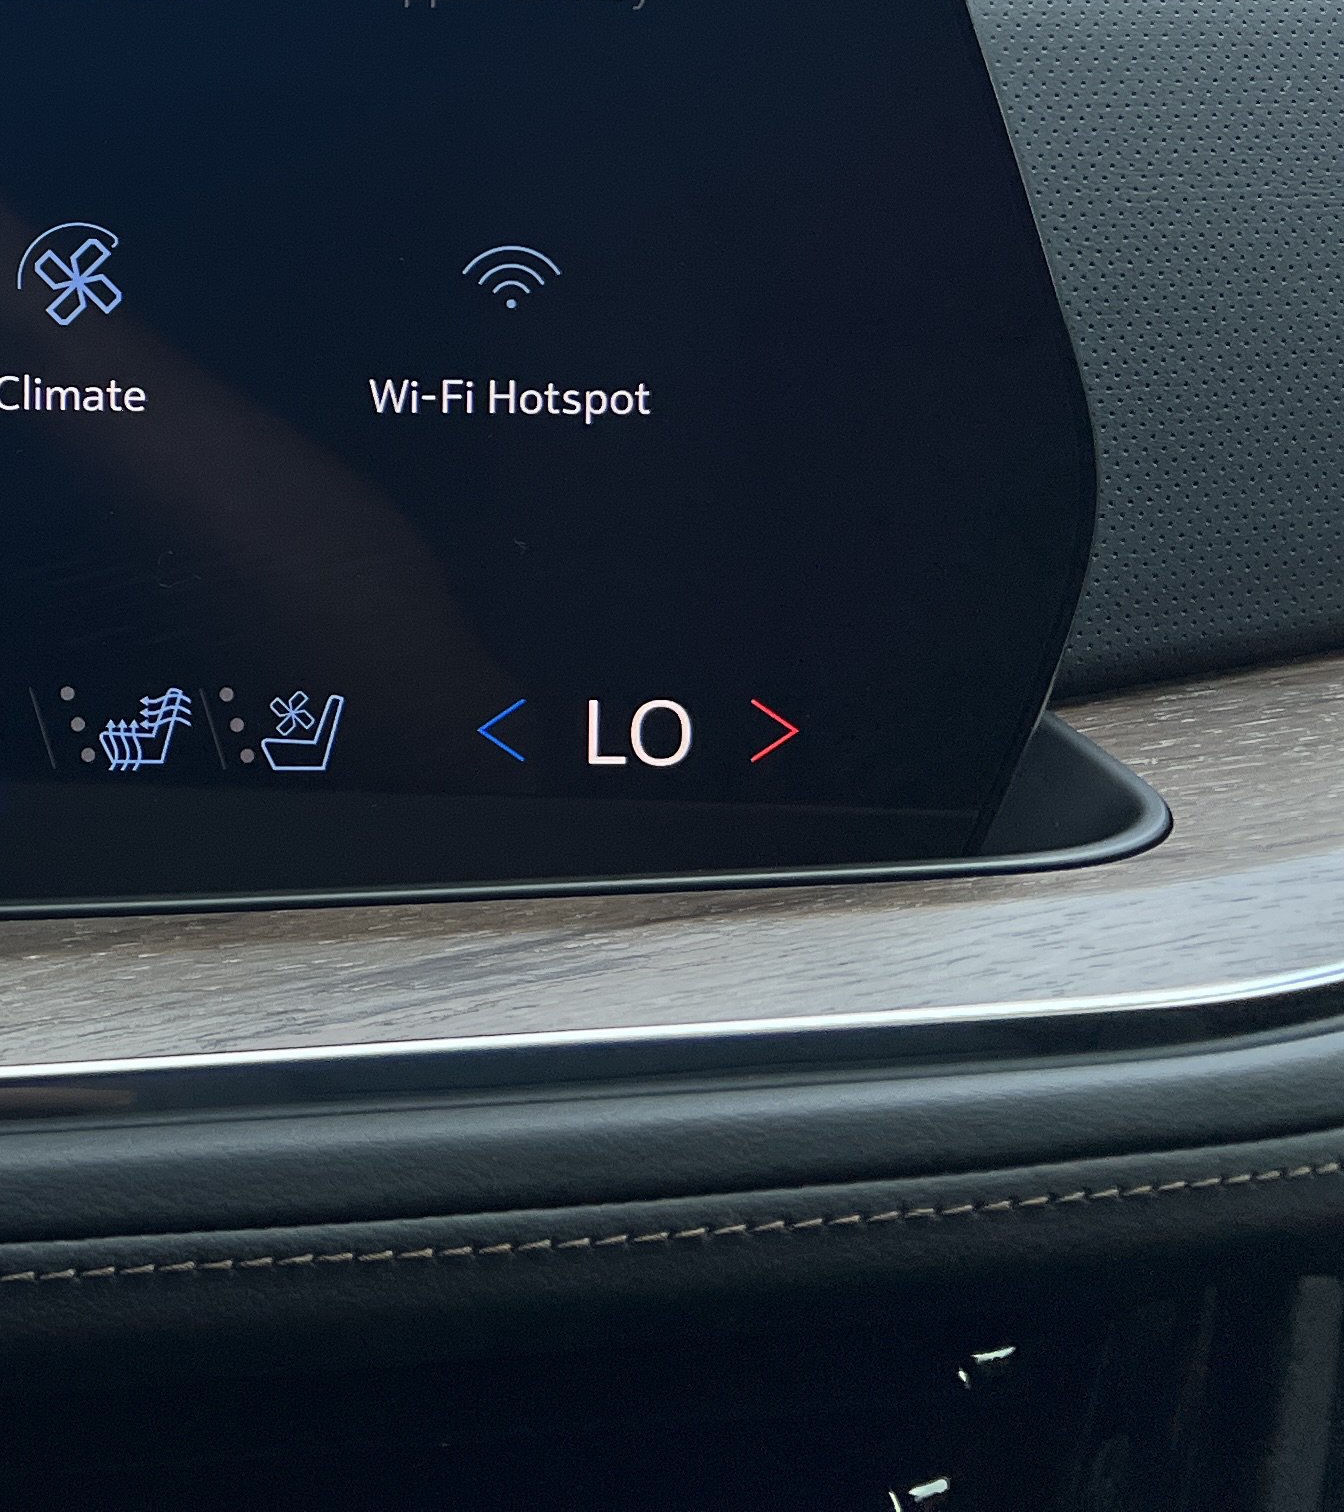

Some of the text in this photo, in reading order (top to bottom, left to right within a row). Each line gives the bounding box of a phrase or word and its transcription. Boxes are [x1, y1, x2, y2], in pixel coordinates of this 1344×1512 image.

[368, 378, 651, 425] Wi-Fi Hotspot
[588, 699, 692, 767] LO
